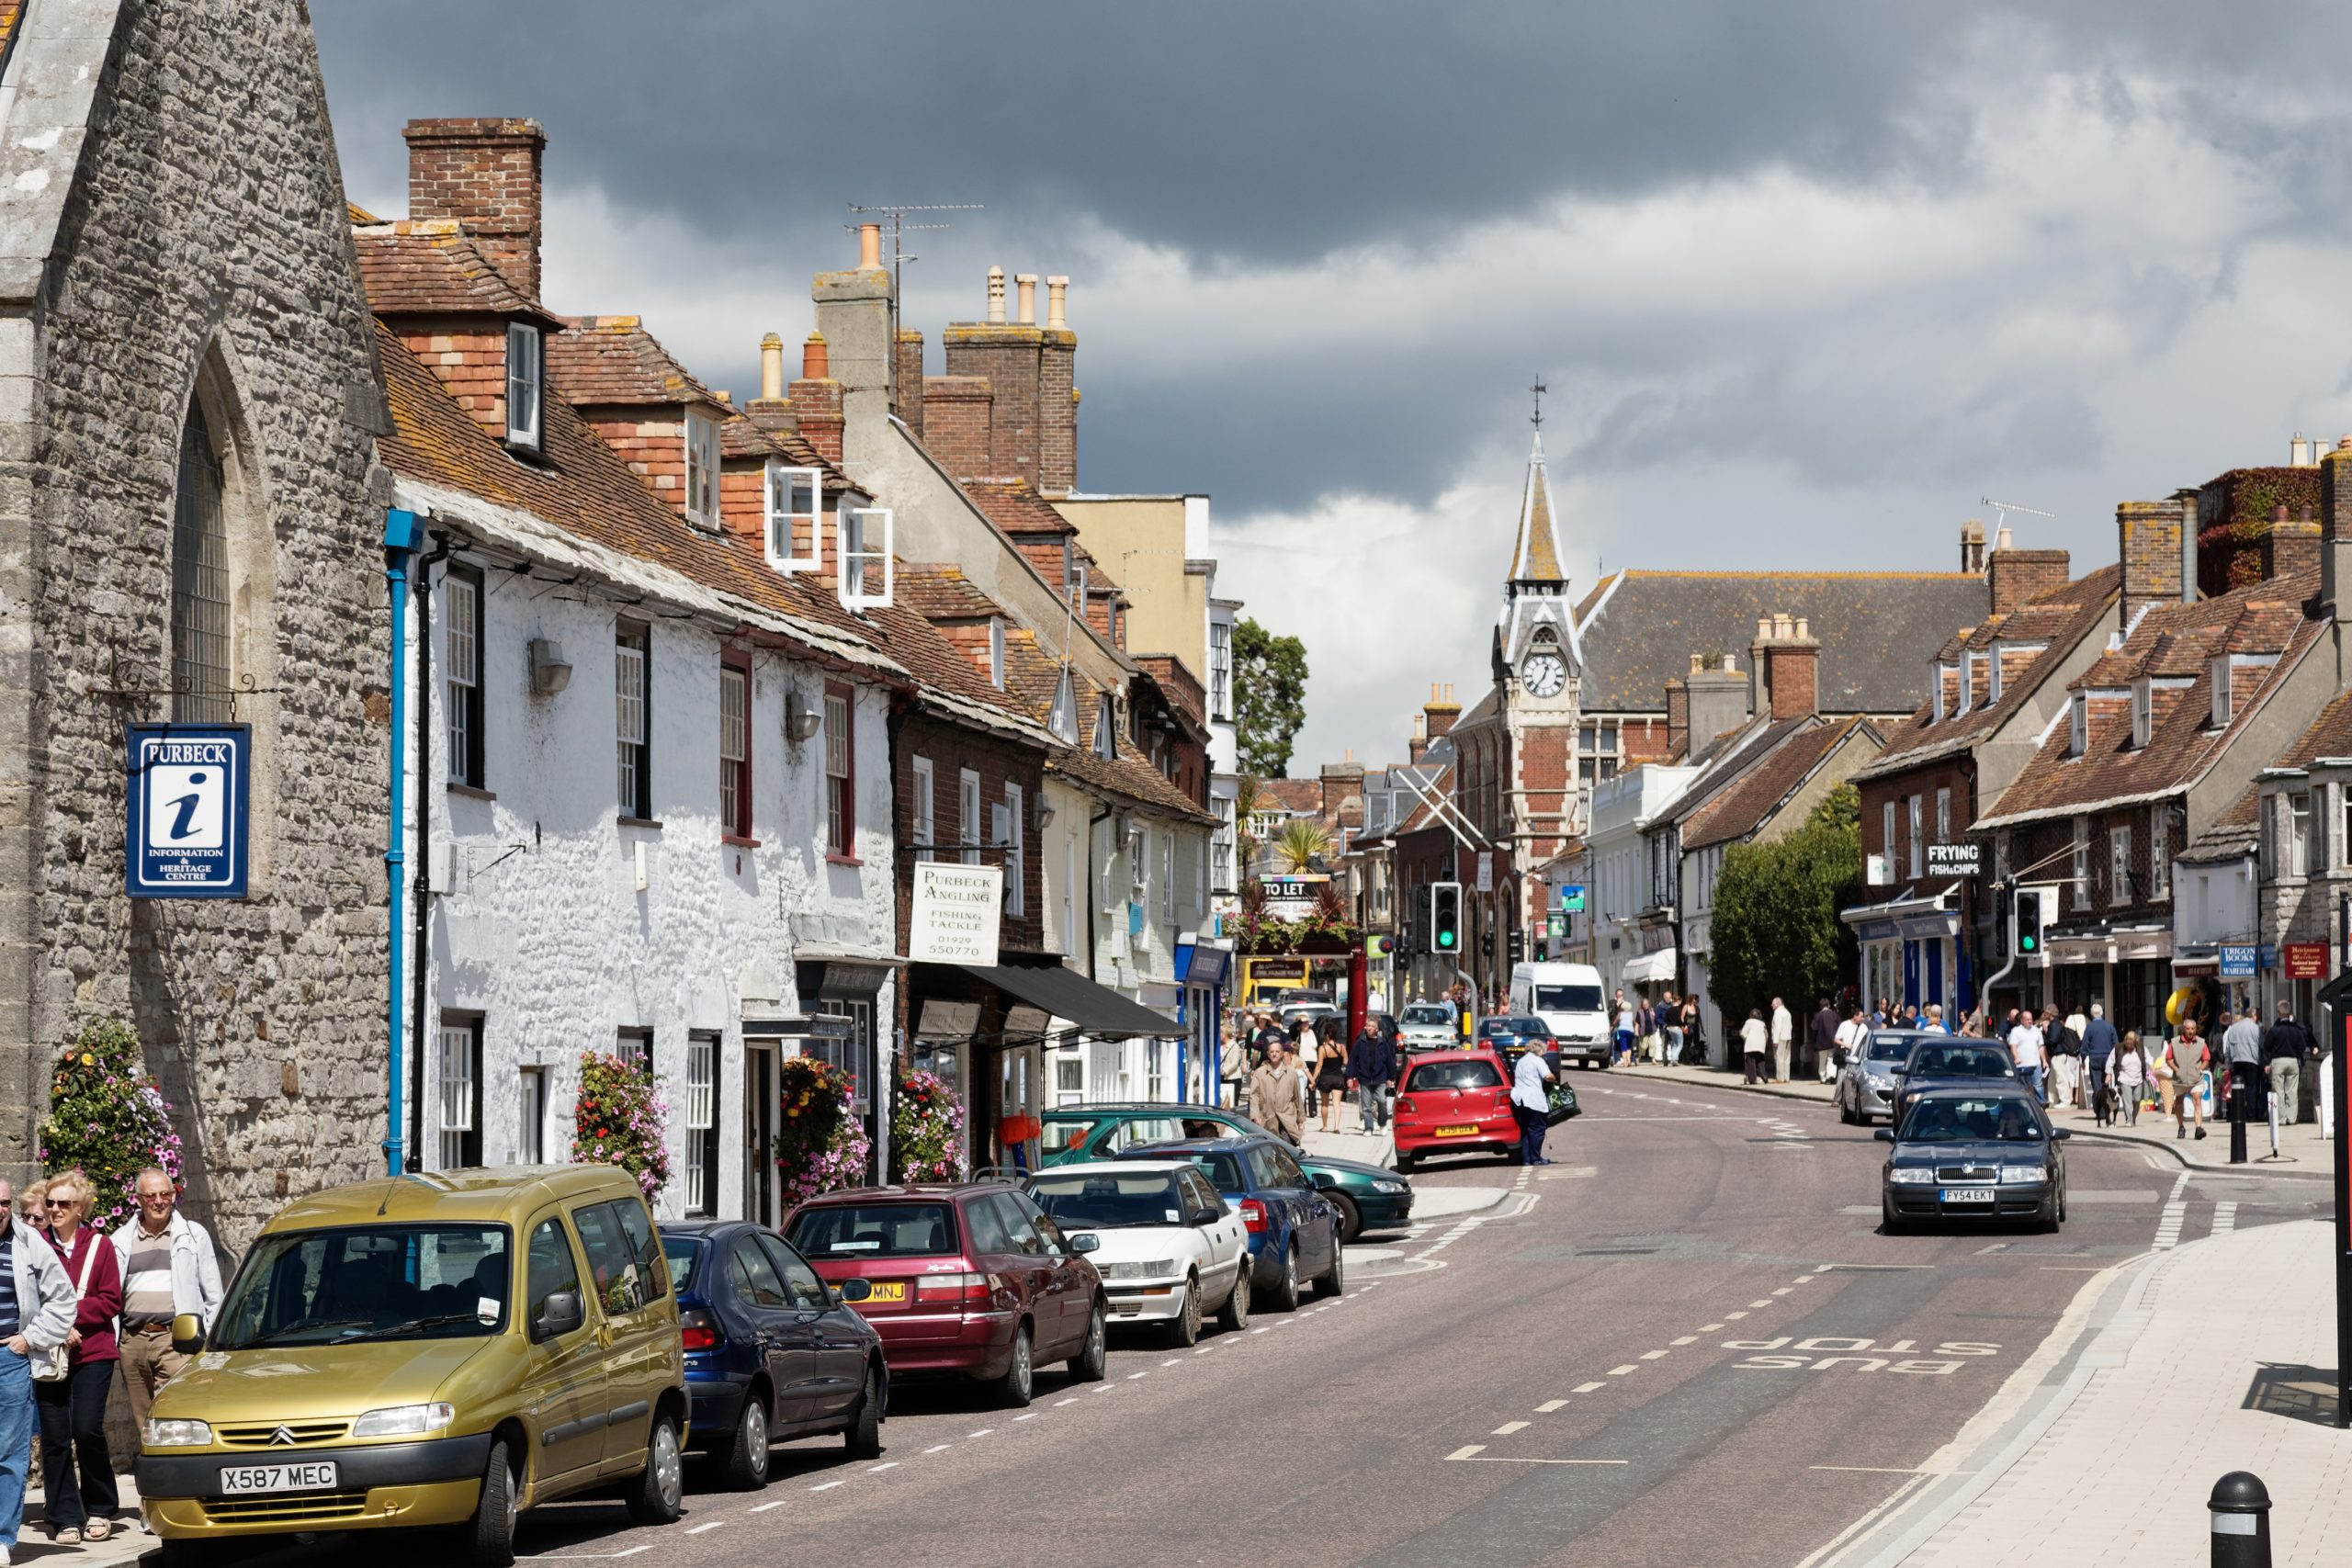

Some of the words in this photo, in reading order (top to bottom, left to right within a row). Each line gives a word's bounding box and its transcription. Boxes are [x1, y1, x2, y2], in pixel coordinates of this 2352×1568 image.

[149, 745, 227, 763] PURBECK
[149, 849, 224, 858] INFORMATION
[1928, 844, 1979, 862] FRYING
[180, 857, 189, 865] &
[159, 864, 212, 873] HERITAGE
[165, 873, 207, 881] CENTRE
[924, 871, 991, 888] PURBECK
[923, 886, 990, 903] ANGLING
[1263, 883, 1281, 896] TO
[1283, 883, 1306, 896] LET
[930, 909, 982, 920] FISHING
[929, 919, 983, 931] TACKLE
[937, 935, 972, 944] 01929
[929, 944, 980, 957] 550770
[2223, 947, 2256, 955] TRIGON
[2223, 966, 2255, 975] WAREHAM
[1946, 1190, 1972, 1201] FY54
[1973, 1190, 1993, 1201] EKT
[874, 1285, 904, 1299] MNJ
[1721, 1337, 2003, 1356] STOP
[1731, 1355, 1966, 1374] BUS
[224, 1468, 281, 1489] X587
[288, 1465, 333, 1486] MEC
